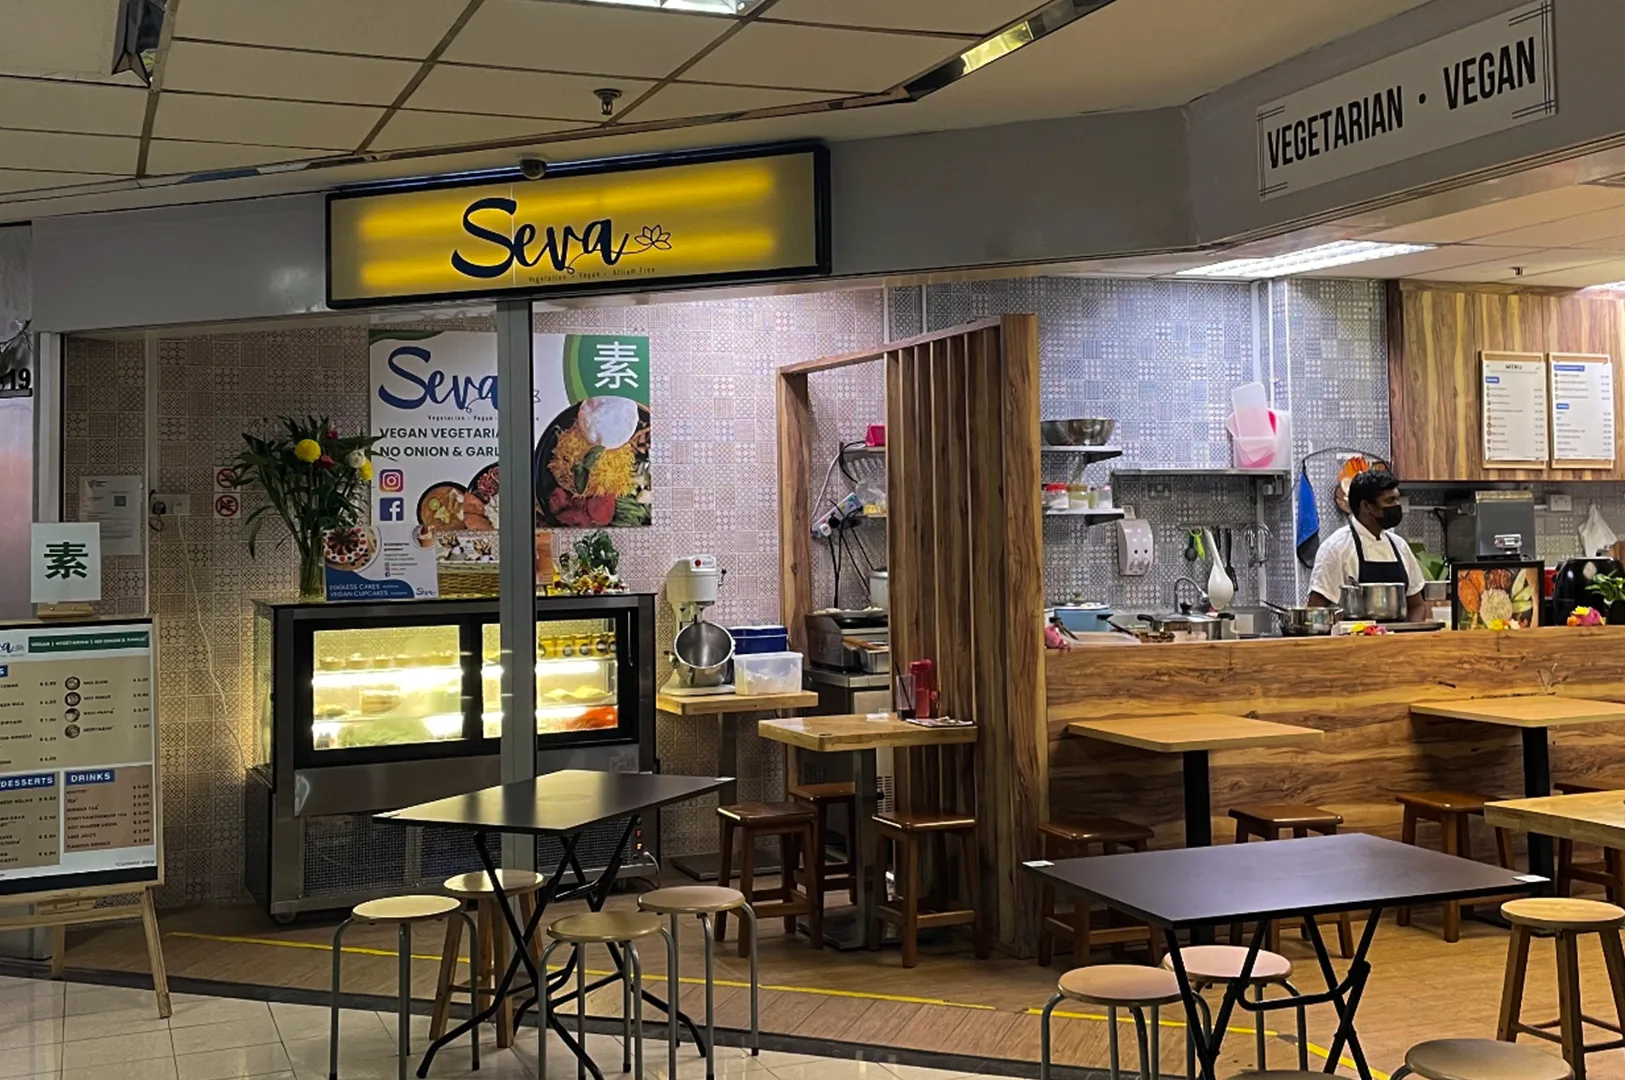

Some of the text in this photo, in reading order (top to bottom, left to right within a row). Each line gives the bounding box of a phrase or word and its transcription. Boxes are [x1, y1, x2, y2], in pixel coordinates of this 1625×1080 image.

[1267, 36, 1537, 169] VEGETARIAN VEGAN
[451, 197, 630, 279] Seva
[378, 346, 499, 411] Seva
[593, 341, 640, 389] 素
[379, 428, 499, 439] VEGAN VEGETARI
[380, 446, 499, 457] NO ONION & GARL
[43, 541, 89, 580] 素
[0, 776, 53, 788] DESSERTS
[71, 772, 111, 783] DRINKS
